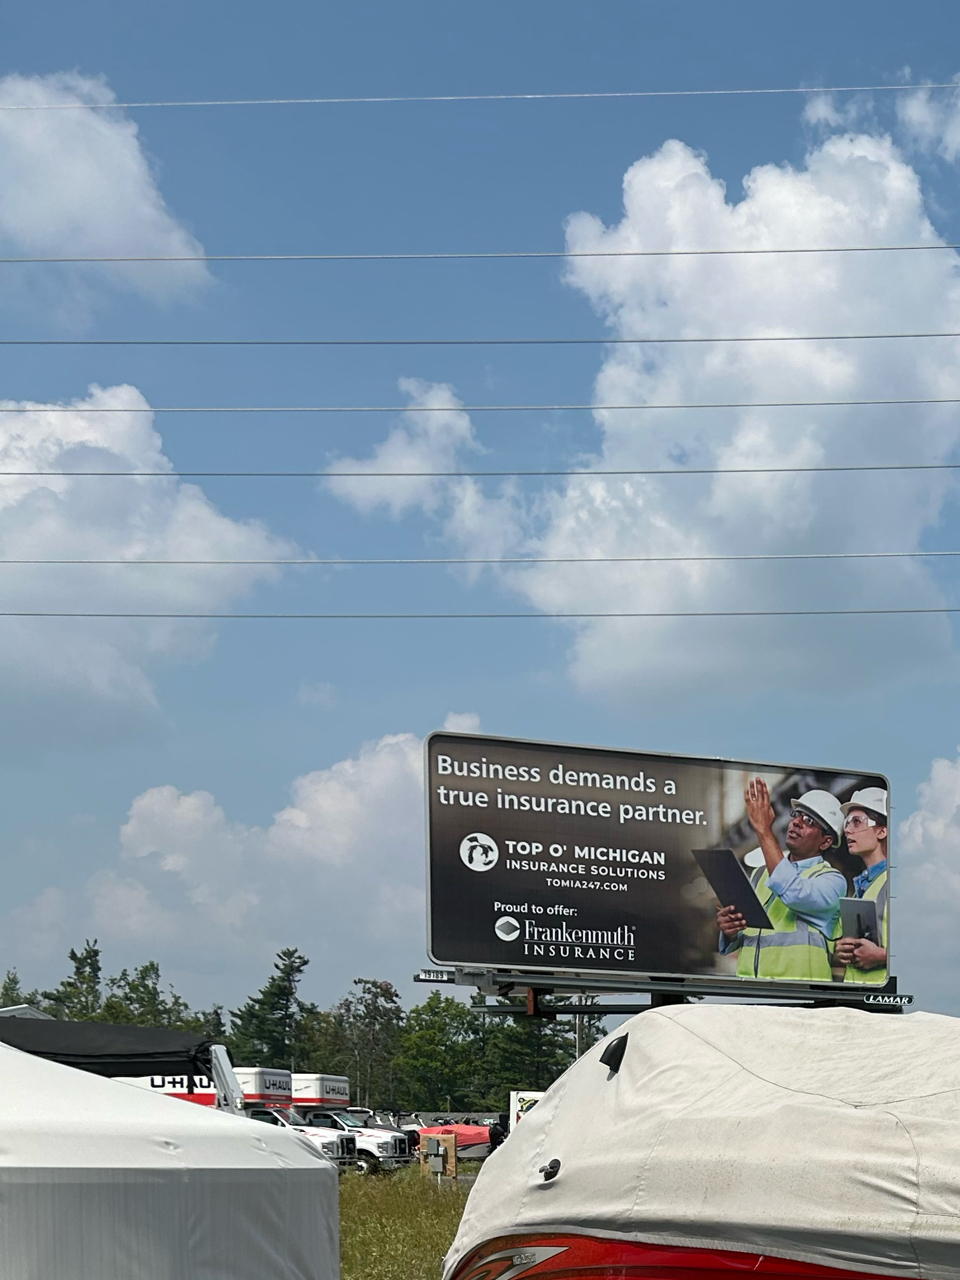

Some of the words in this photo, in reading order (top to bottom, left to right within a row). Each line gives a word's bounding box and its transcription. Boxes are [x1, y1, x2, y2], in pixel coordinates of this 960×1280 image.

[437, 754, 542, 783] Business
[549, 764, 656, 793] demands
[663, 779, 677, 795] a
[437, 785, 489, 808] true
[497, 788, 611, 818] insurance
[619, 802, 708, 826] partner.
[505, 840, 543, 856] TOP
[549, 843, 567, 857] O'
[574, 846, 666, 865] MICHIGAN
[505, 859, 586, 875] INSURANCE
[590, 865, 666, 881] SOLUTIONS
[545, 878, 628, 892] TOMIA247.COM
[494, 901, 528, 914] Proud
[531, 904, 543, 915] to
[547, 904, 578, 917] offer:
[523, 919, 635, 946] Frankenmuth
[523, 943, 635, 961] INSURANCE
[869, 994, 909, 1005] LAMAR
[264, 1078, 292, 1091] U-HAUL
[325, 1084, 349, 1096] U-HAUL
